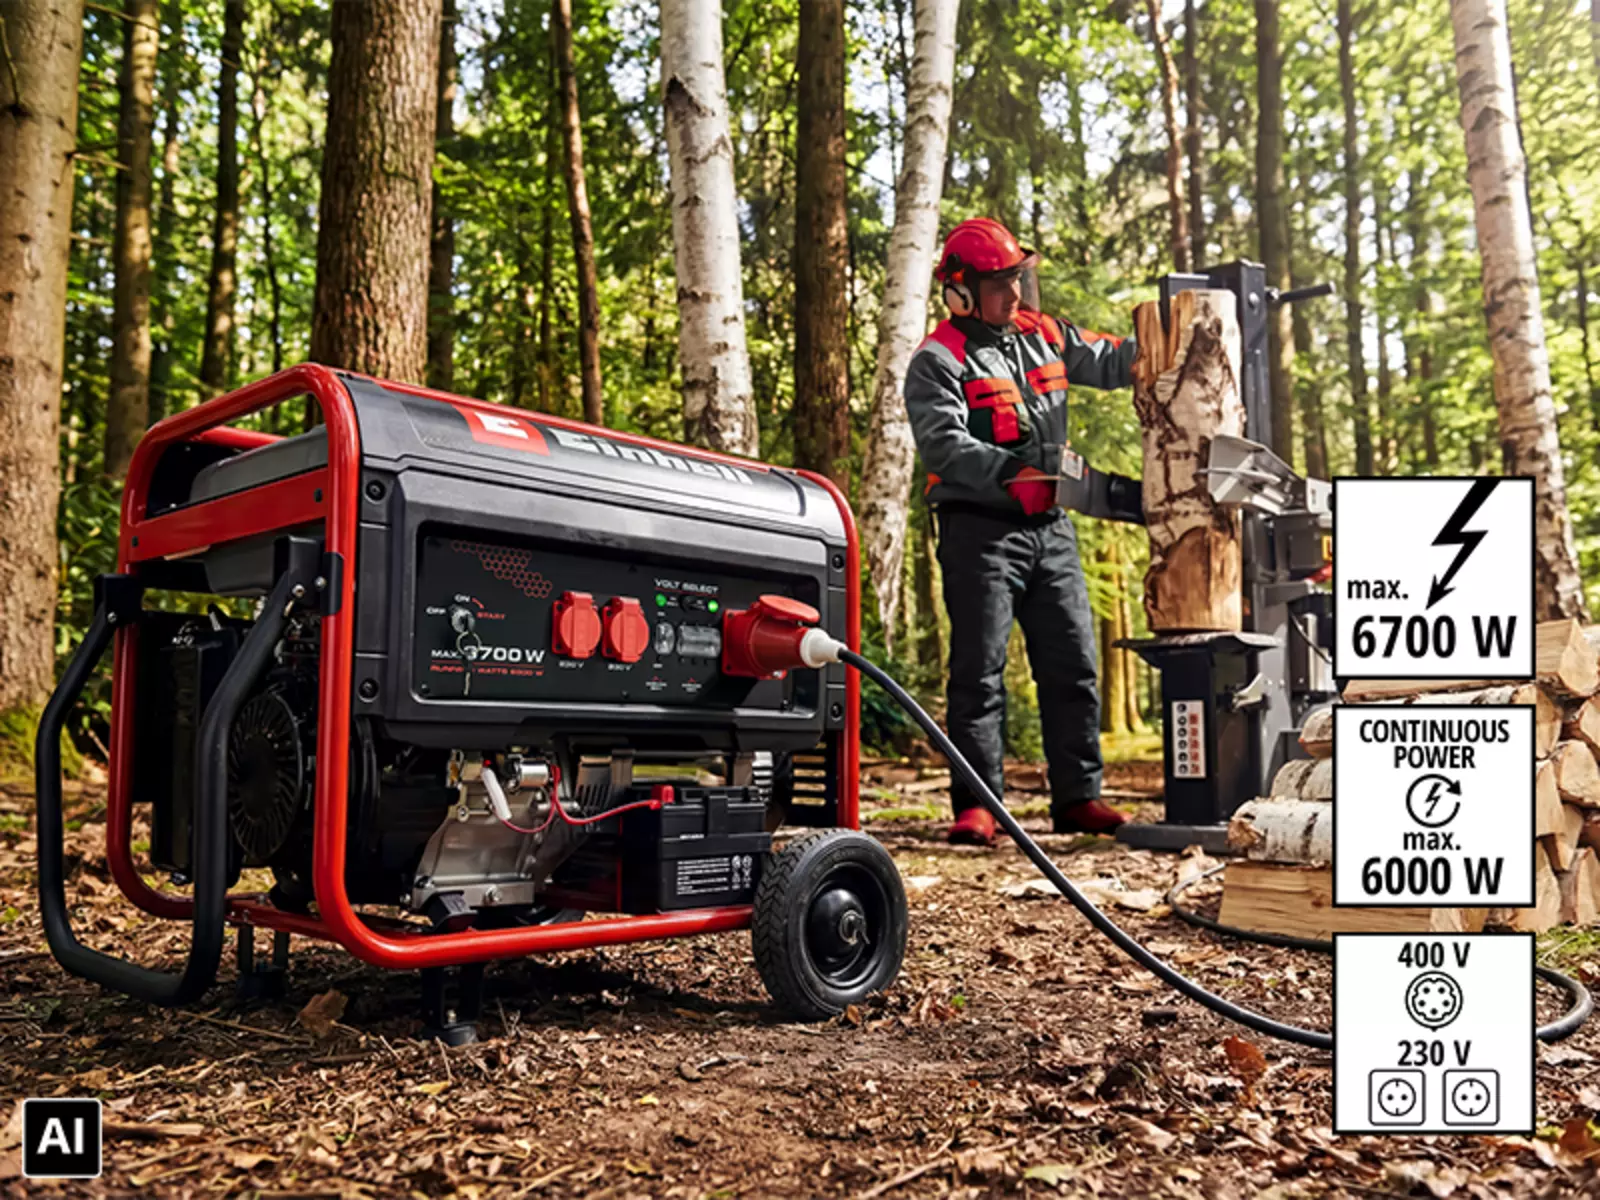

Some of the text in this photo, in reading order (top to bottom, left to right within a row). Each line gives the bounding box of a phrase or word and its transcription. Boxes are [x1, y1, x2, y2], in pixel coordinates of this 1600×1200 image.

[547, 427, 753, 485] Einhell
[655, 579, 718, 594] VOLT SELECT
[525, 649, 545, 663] W
